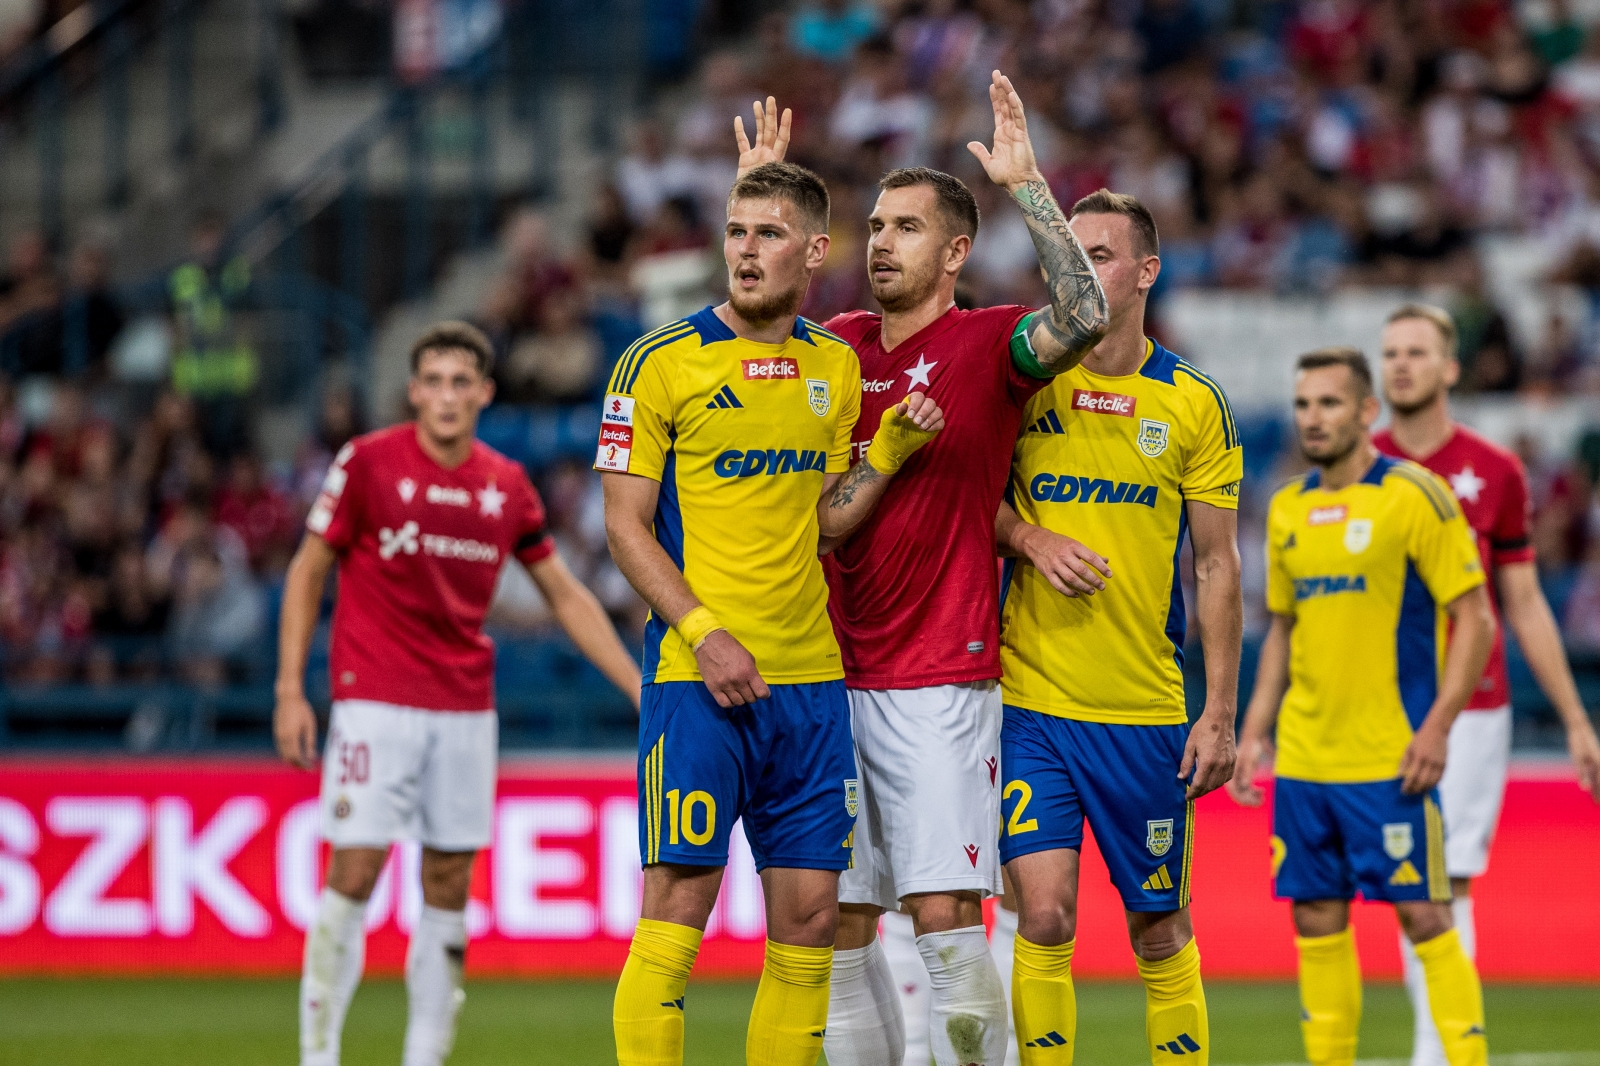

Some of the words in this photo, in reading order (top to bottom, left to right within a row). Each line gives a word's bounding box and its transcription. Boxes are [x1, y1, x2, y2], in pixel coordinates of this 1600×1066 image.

[748, 358, 796, 377] Betclic
[1076, 393, 1131, 413] Betclic
[605, 413, 628, 423] SUZUKI
[602, 430, 630, 441] Betclic
[1142, 437, 1163, 446] ARKA
[714, 449, 827, 478] GDYNIA
[1030, 472, 1158, 508] GDYNIA
[339, 741, 370, 786] 50
[665, 788, 717, 846] 10
[1000, 779, 1039, 838] 2
